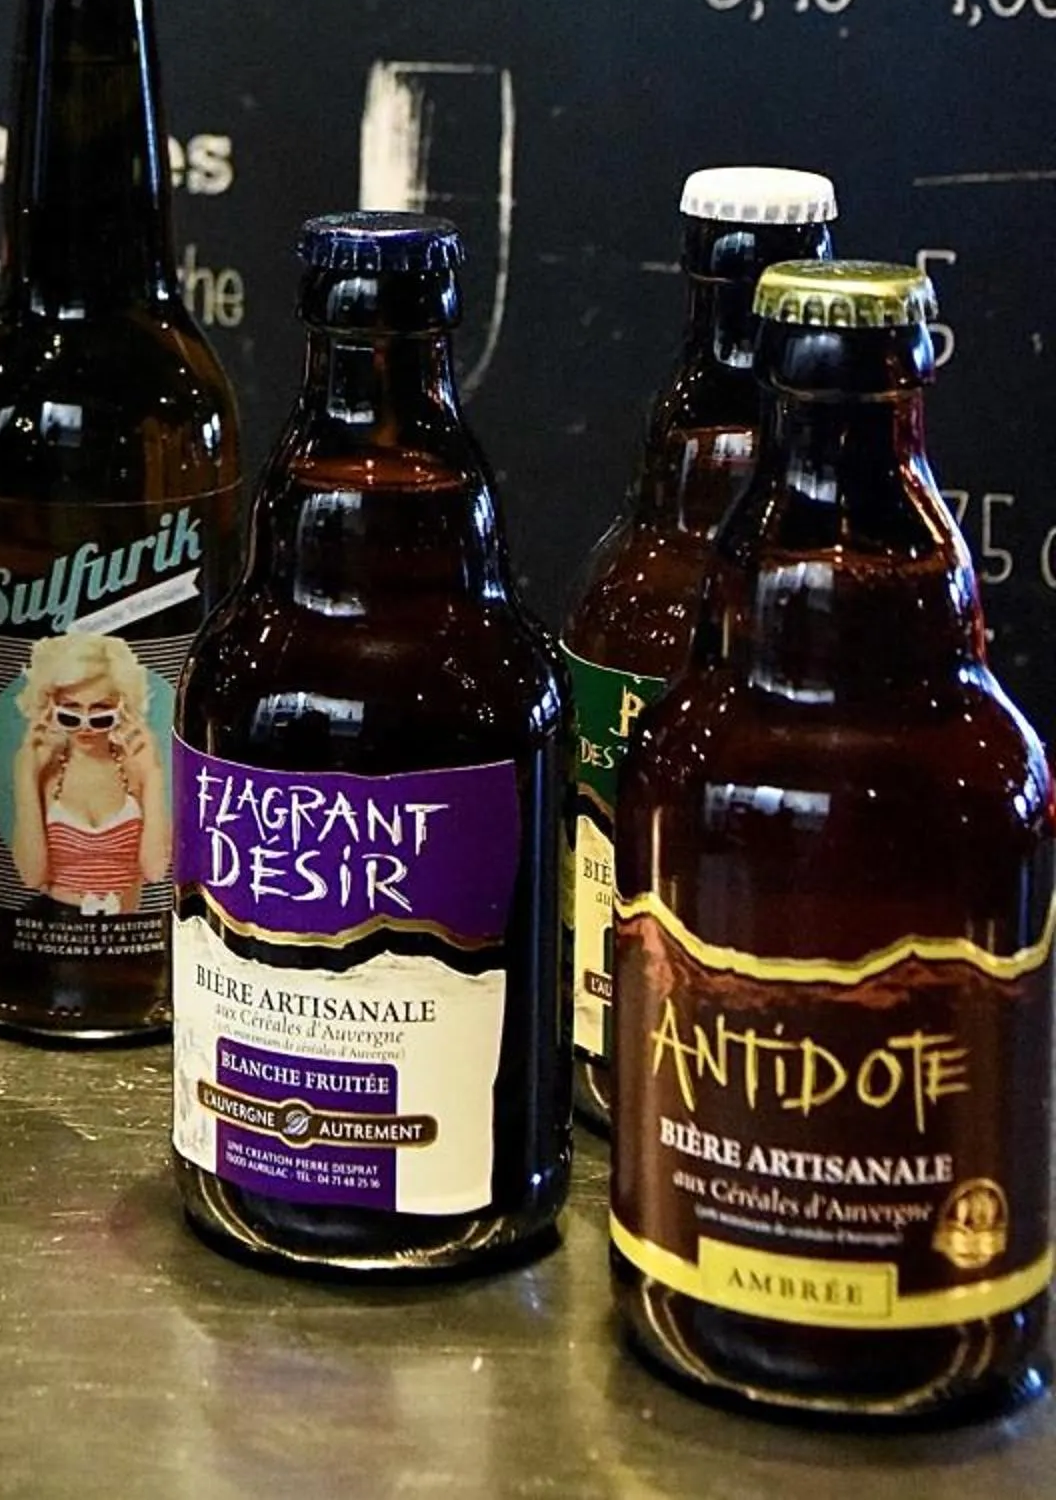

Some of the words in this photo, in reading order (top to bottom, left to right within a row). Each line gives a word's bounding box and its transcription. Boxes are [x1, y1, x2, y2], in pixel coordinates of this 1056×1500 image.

[196, 767, 448, 855] FLAGRANT
[583, 857, 612, 886] BIÈ
[196, 964, 253, 1007] BIÈRE
[258, 988, 436, 1023] ARTISANALE
[307, 1020, 404, 1047] d'Auvergne
[221, 1050, 301, 1086] BLANCHE
[306, 1070, 390, 1095] FRUITÉE
[203, 1089, 276, 1128] L'AUVERGNE
[319, 1122, 423, 1141] AUTREMENT
[660, 1117, 741, 1168] BIÈRE
[747, 1146, 954, 1185] ARTISANALE
[728, 1266, 863, 1306] AMBRÉE
